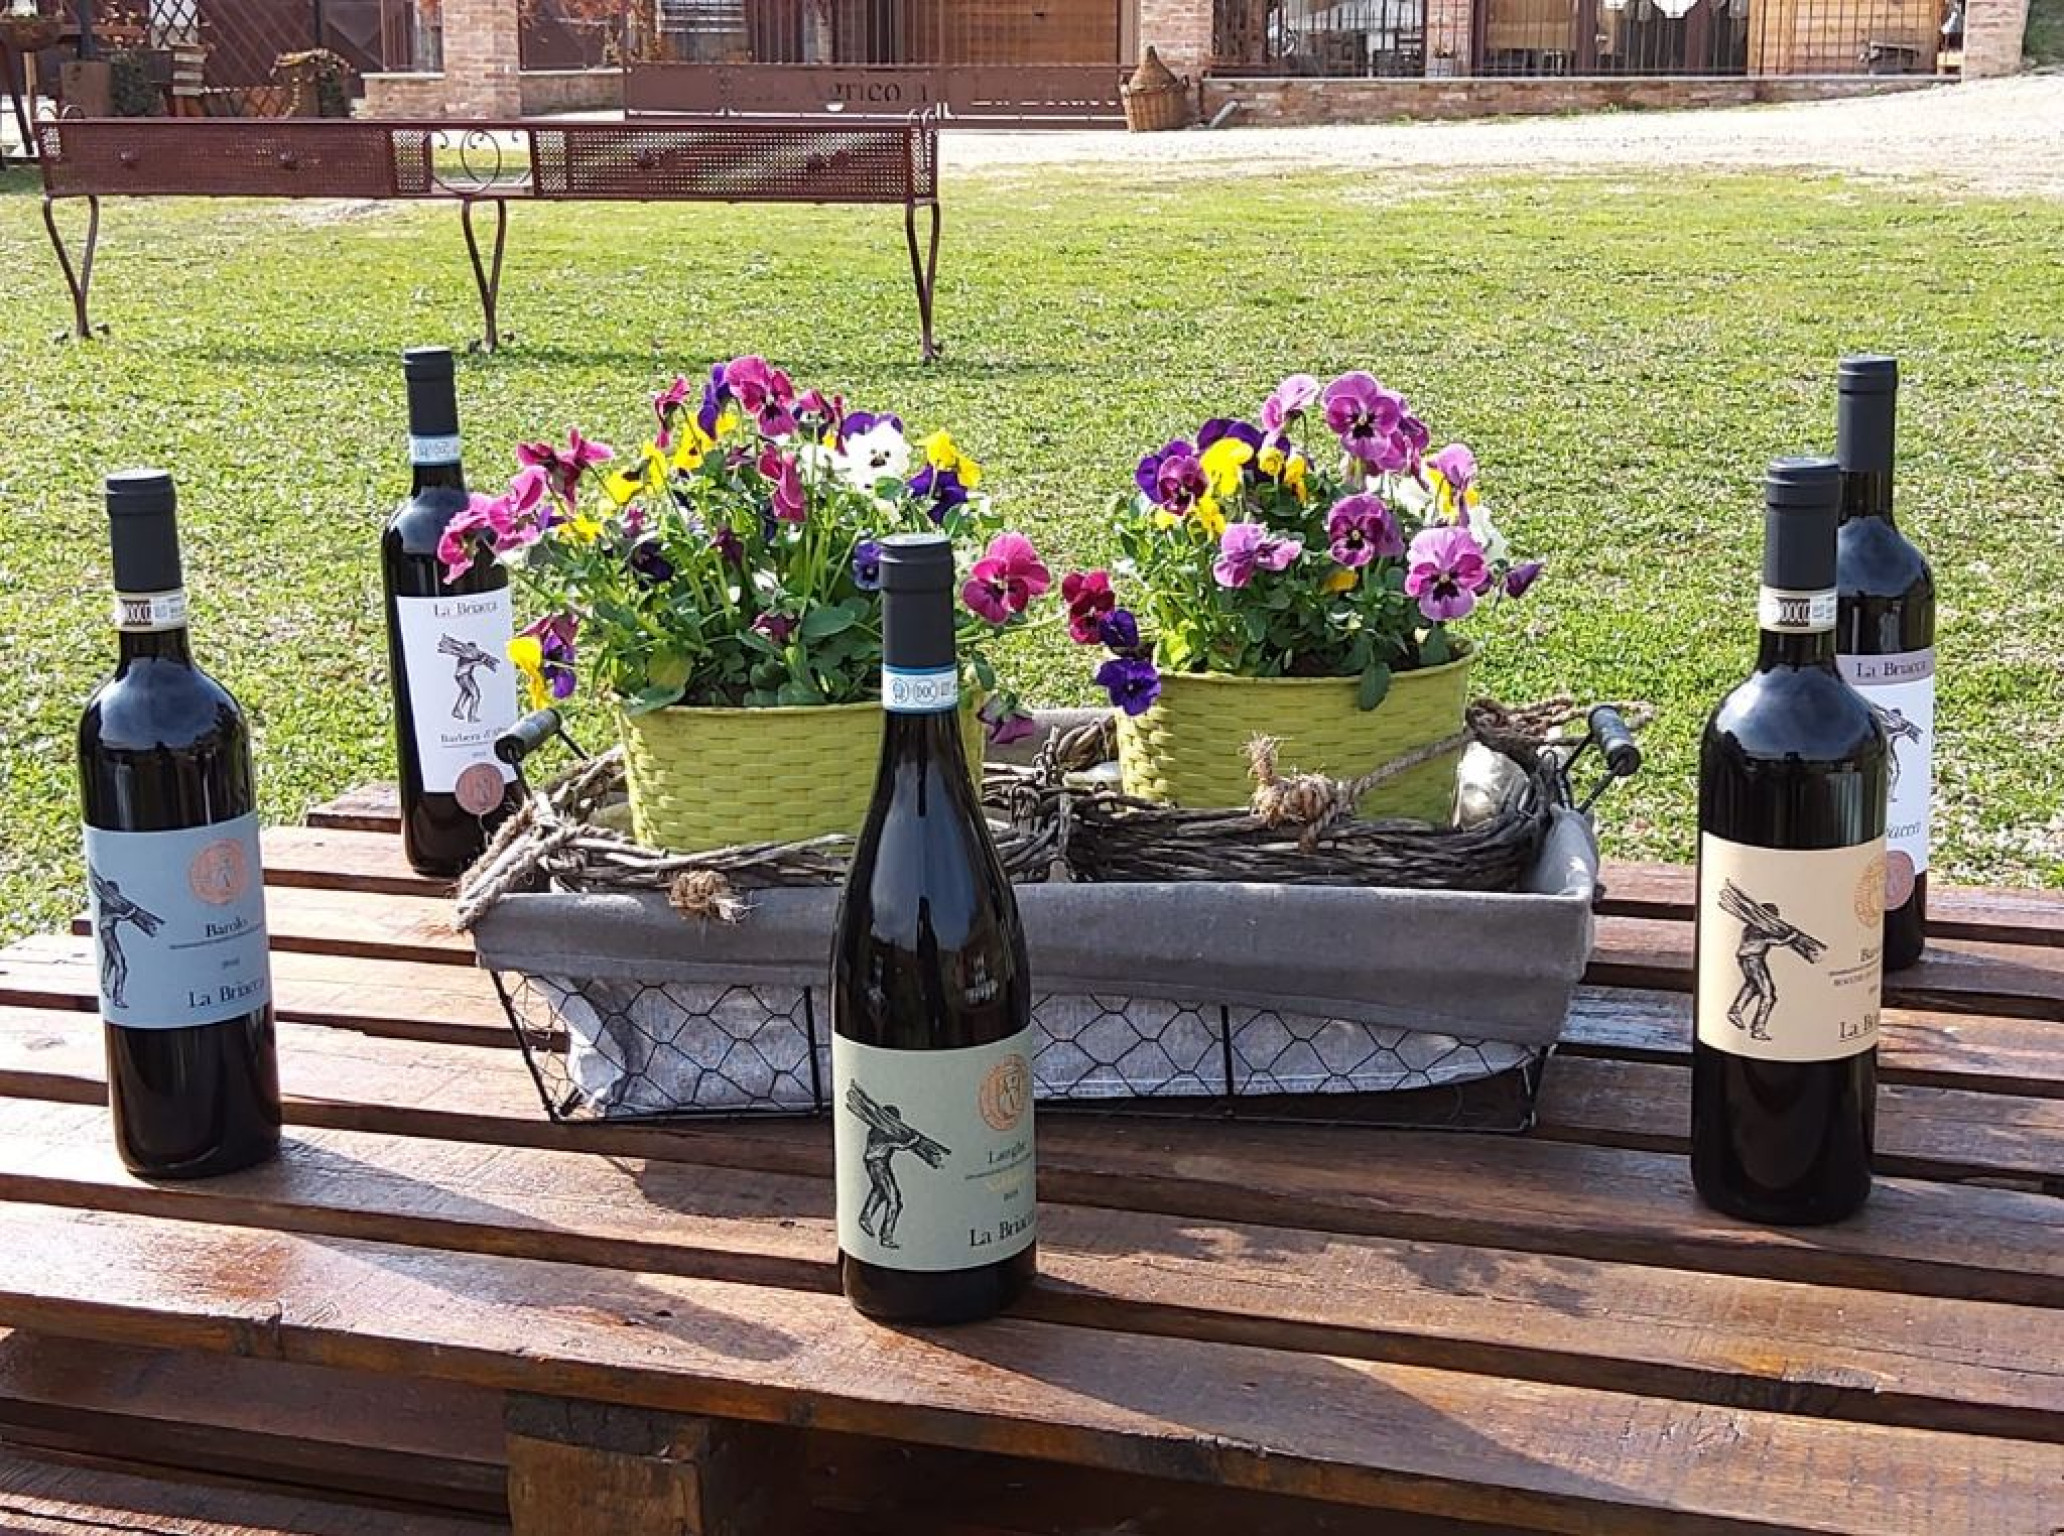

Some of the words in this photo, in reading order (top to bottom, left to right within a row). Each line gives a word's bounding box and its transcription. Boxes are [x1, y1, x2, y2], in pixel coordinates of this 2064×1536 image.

[1856, 662, 1876, 677] La
[189, 991, 211, 1008] La
[1839, 1021, 1858, 1038] La
[970, 1228, 991, 1247] La
